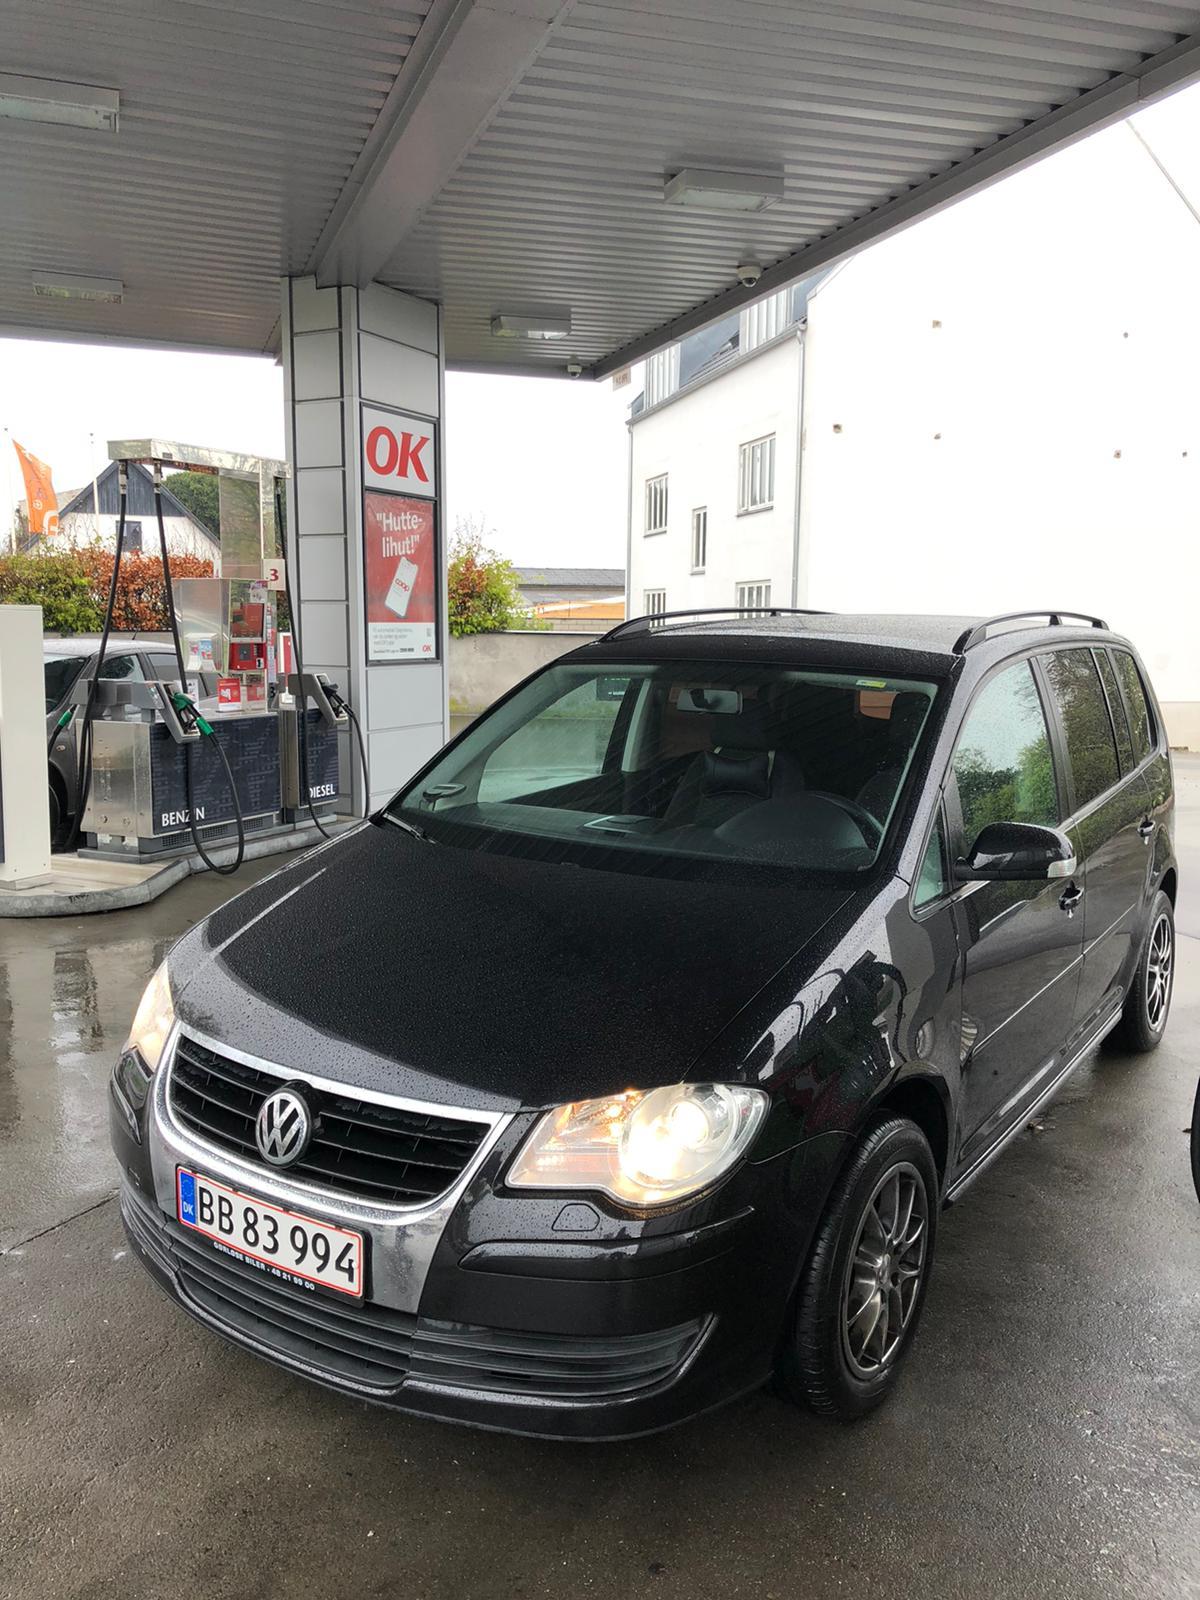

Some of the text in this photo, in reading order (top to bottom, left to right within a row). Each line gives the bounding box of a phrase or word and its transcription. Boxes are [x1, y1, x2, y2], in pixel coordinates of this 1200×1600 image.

[366, 426, 430, 482] OK
[376, 512, 423, 532] "Hutte-
[382, 534, 420, 557] lihut!"
[269, 568, 279, 582] 3
[422, 644, 432, 653] OK
[161, 806, 205, 827] BENZN
[182, 1202, 194, 1217] DK
[199, 1186, 354, 1283] BB 83 994
